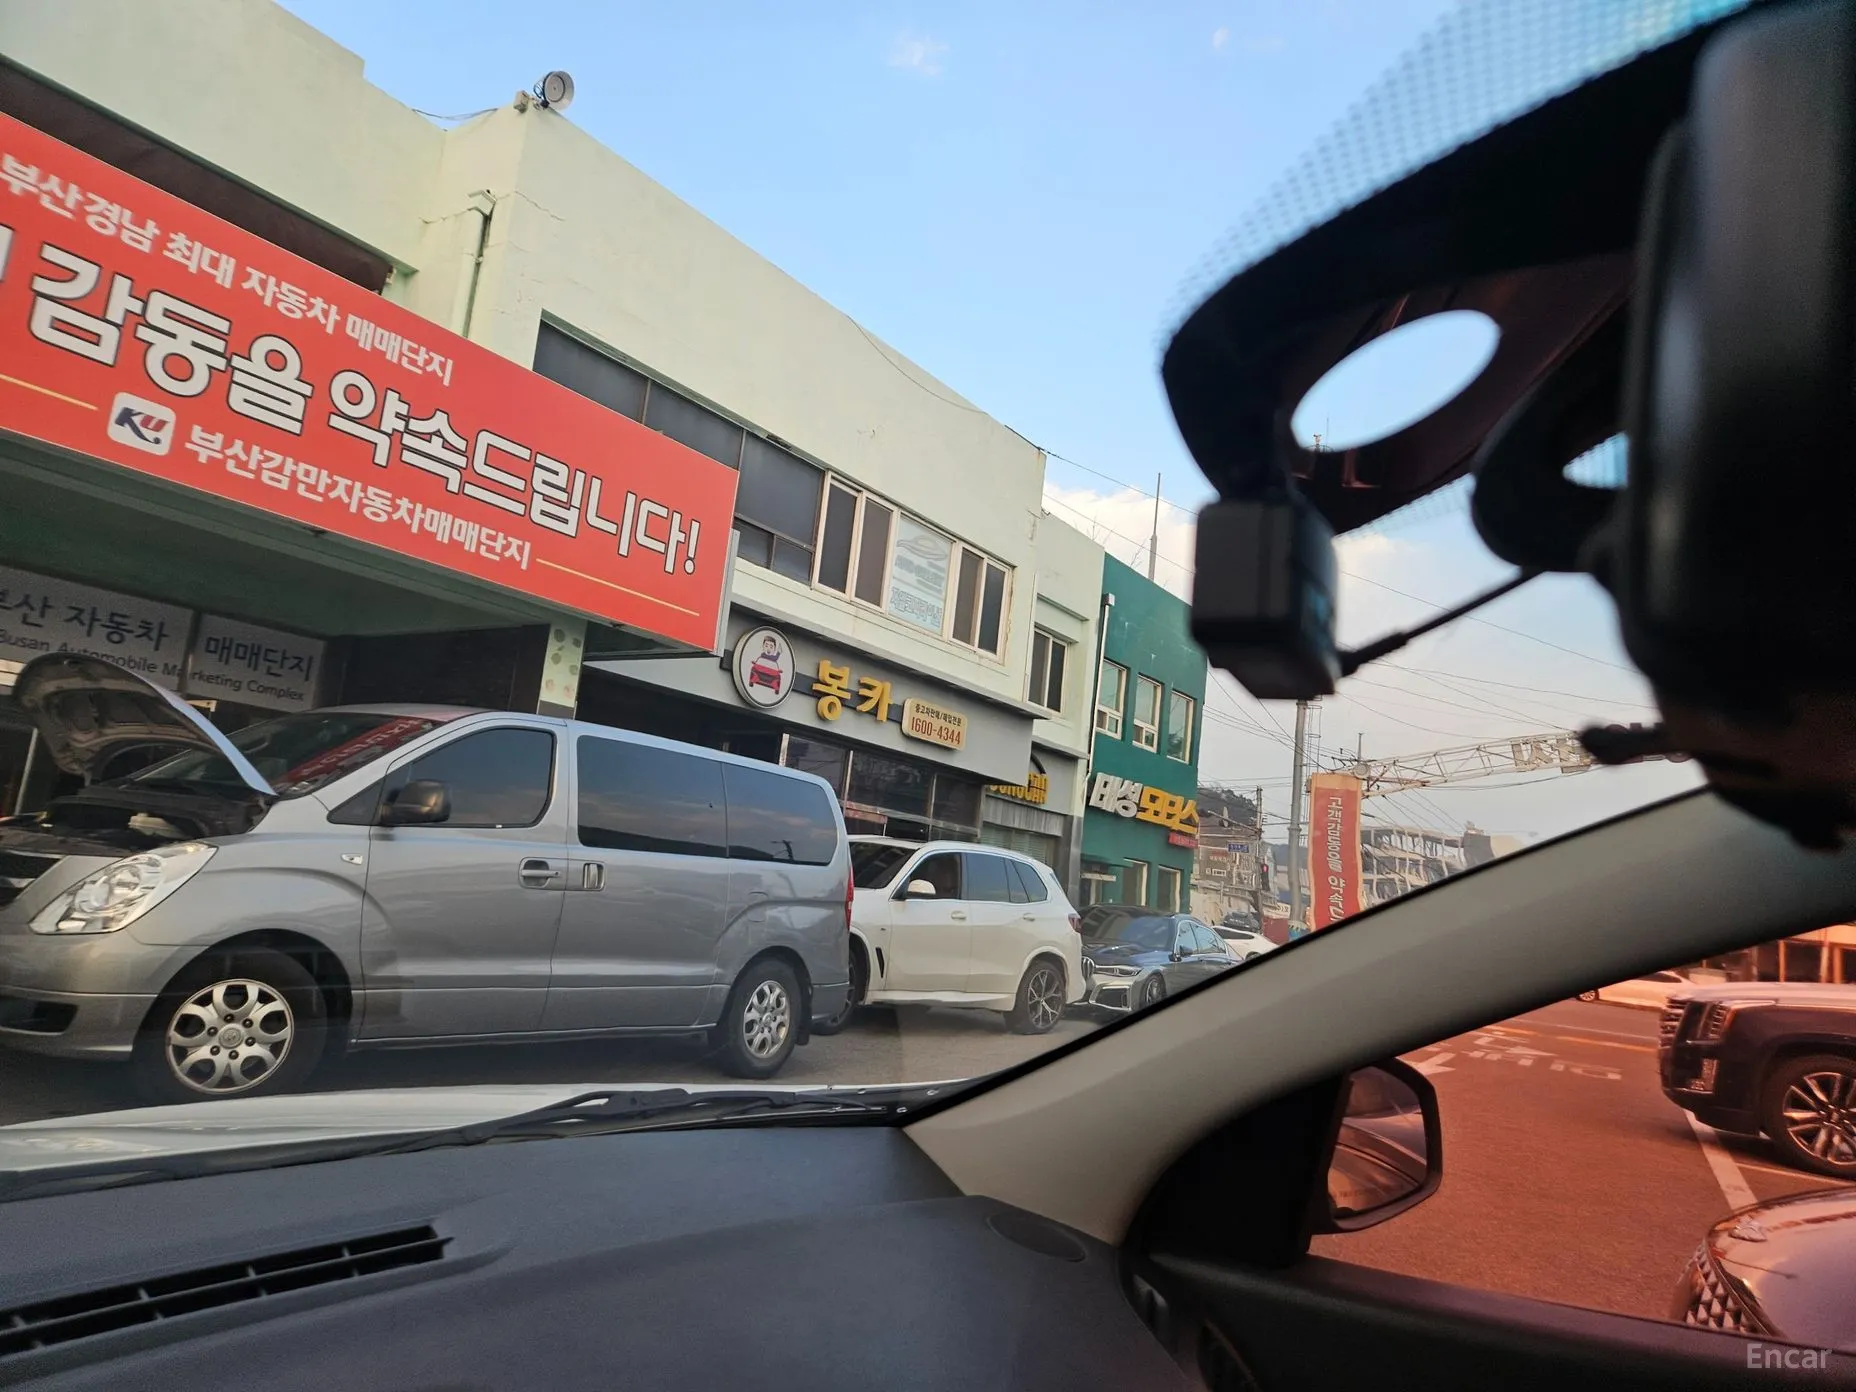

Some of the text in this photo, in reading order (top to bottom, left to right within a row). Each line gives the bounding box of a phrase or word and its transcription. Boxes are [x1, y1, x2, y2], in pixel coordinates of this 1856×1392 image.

[1, 154, 160, 252] 부산경남
[162, 233, 236, 289] 최대
[242, 265, 341, 335] 자동차
[345, 314, 454, 387] 매매단지
[28, 241, 700, 575] 감동을 약속드립니다!
[185, 425, 531, 571] 부산감만자동차매매단지
[64, 604, 169, 652] 자동차
[205, 636, 314, 682] 매매단지
[162, 662, 242, 692] Marketing
[247, 680, 304, 701] Complex
[812, 660, 893, 722] 봉카
[911, 716, 961, 745] 1600-4344
[1327, 796, 1344, 873] 고객감동을
